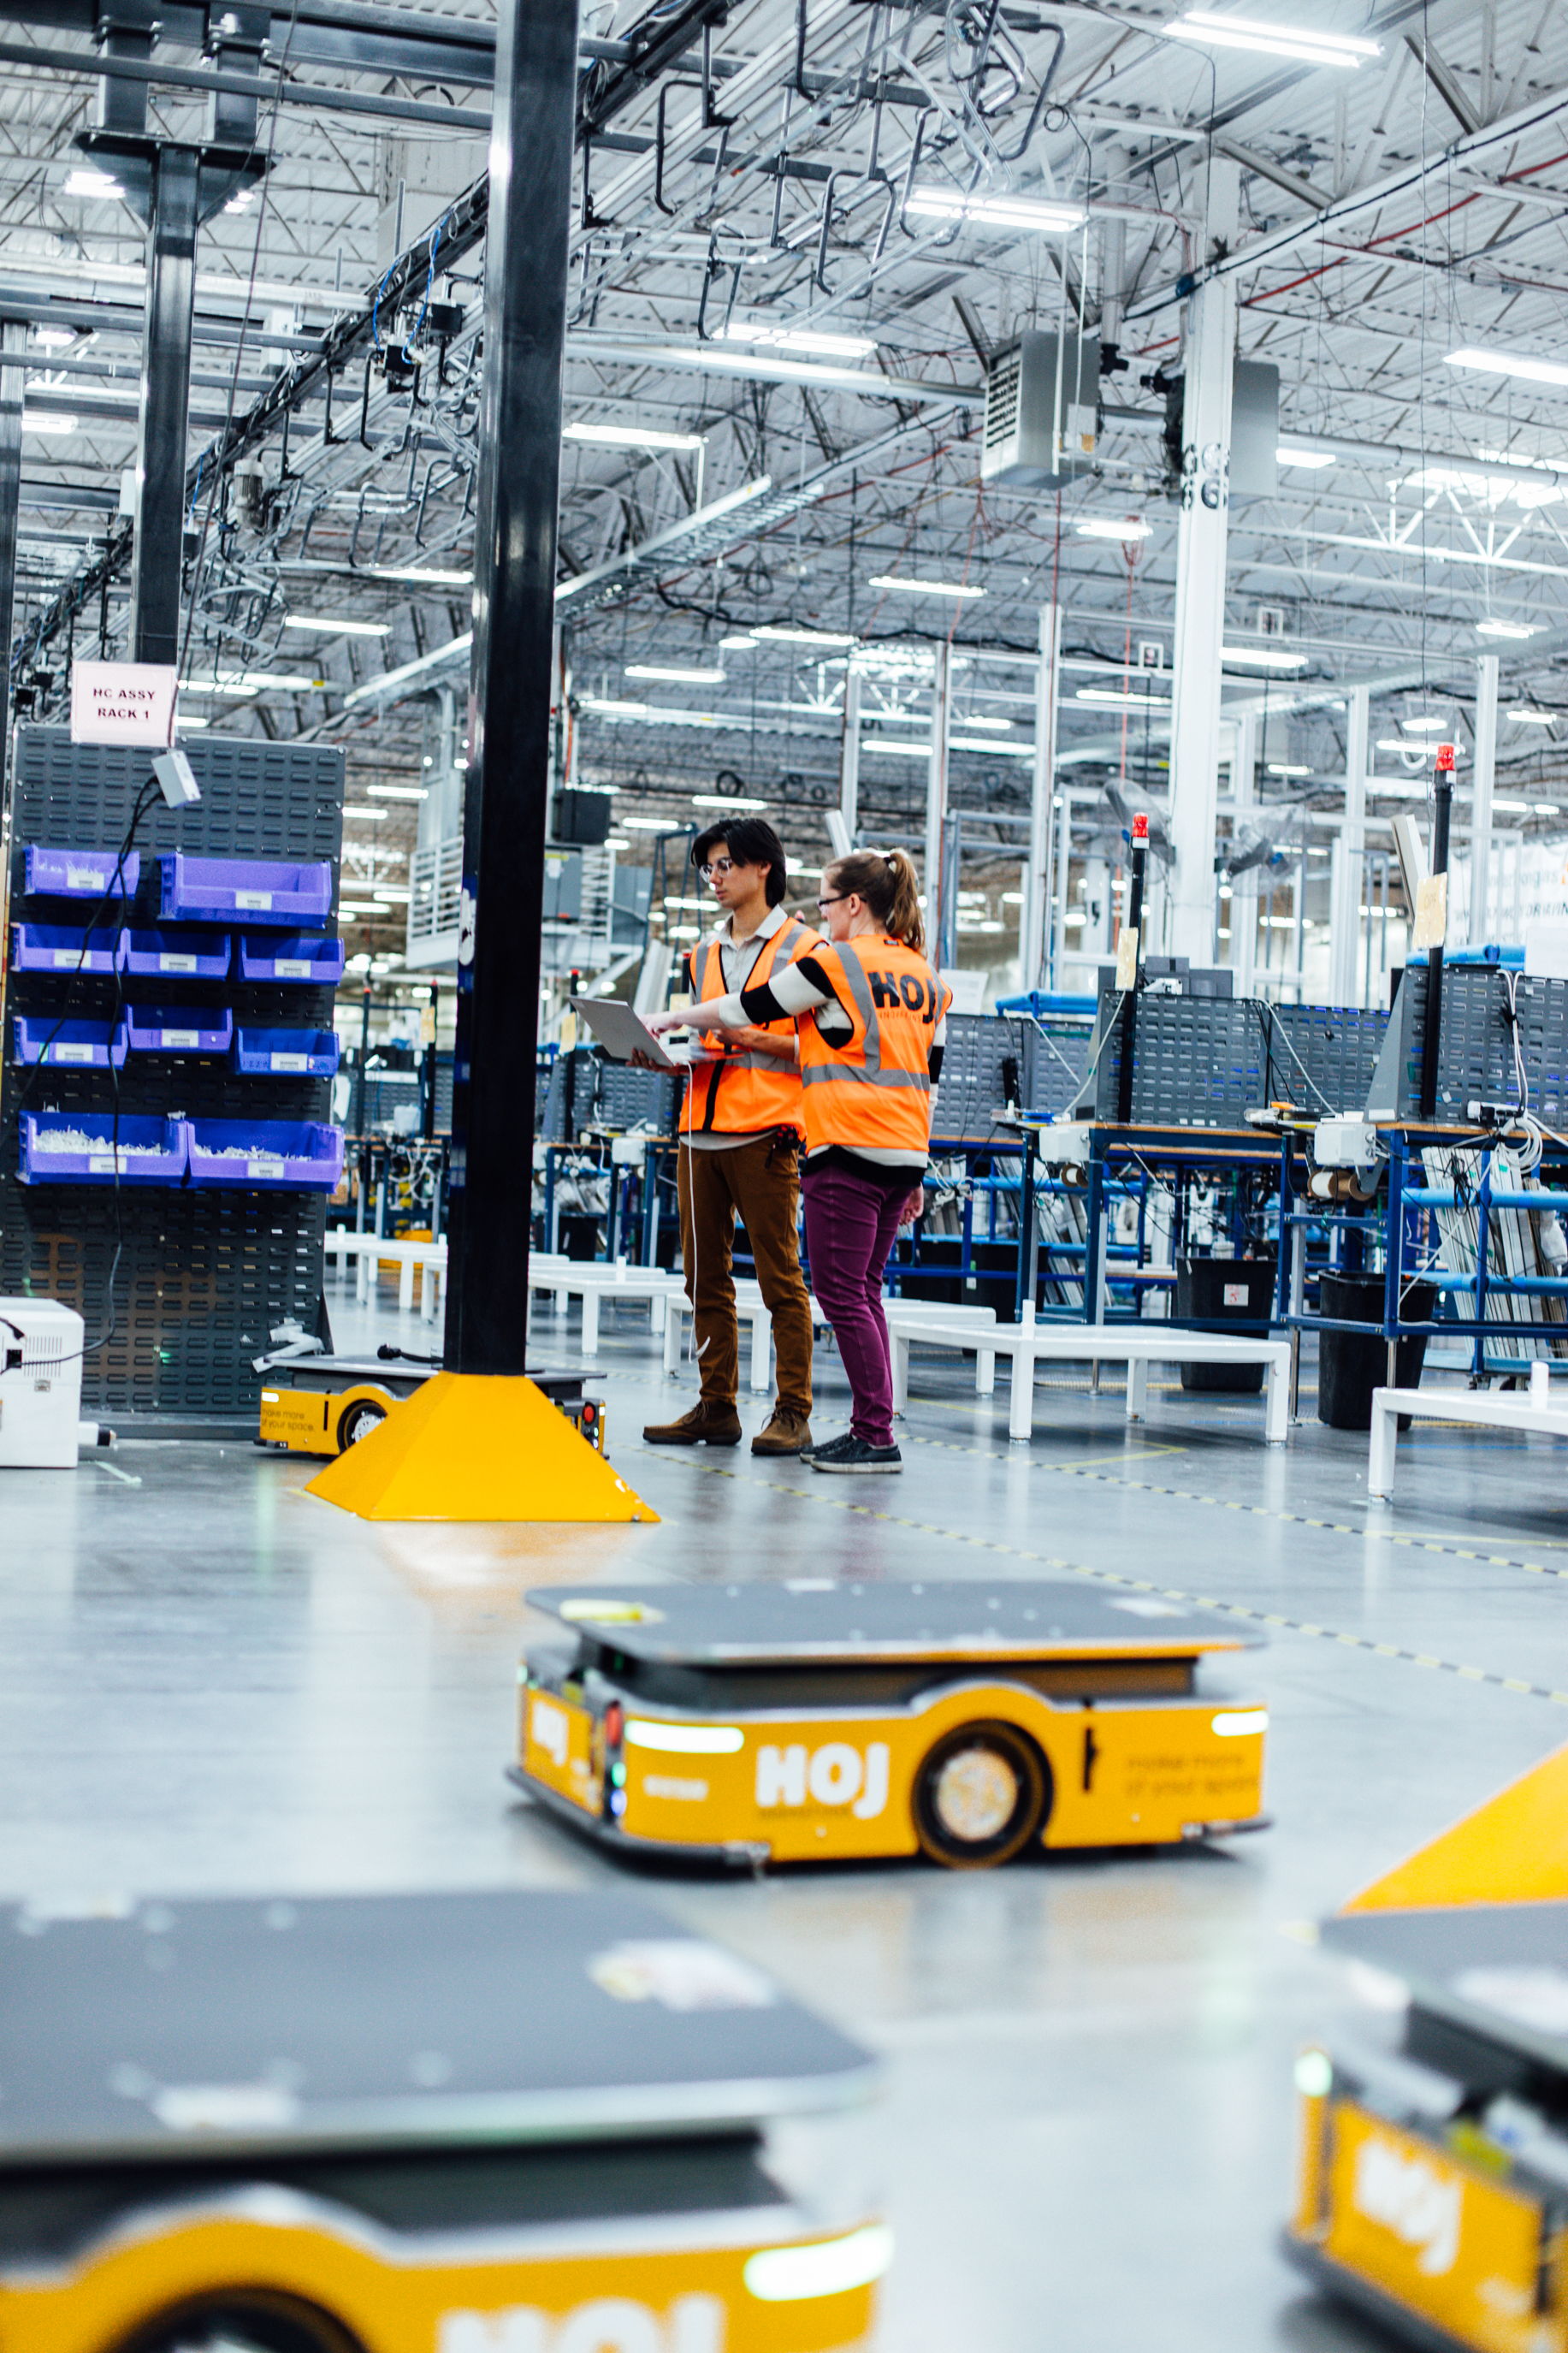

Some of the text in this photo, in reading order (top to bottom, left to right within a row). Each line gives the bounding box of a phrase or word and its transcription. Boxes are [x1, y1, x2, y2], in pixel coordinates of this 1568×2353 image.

[92, 688, 155, 700] HC ASSY
[98, 708, 149, 719] RACK 1
[867, 971, 936, 1024] HOJ
[755, 1742, 890, 1819] HOJ
